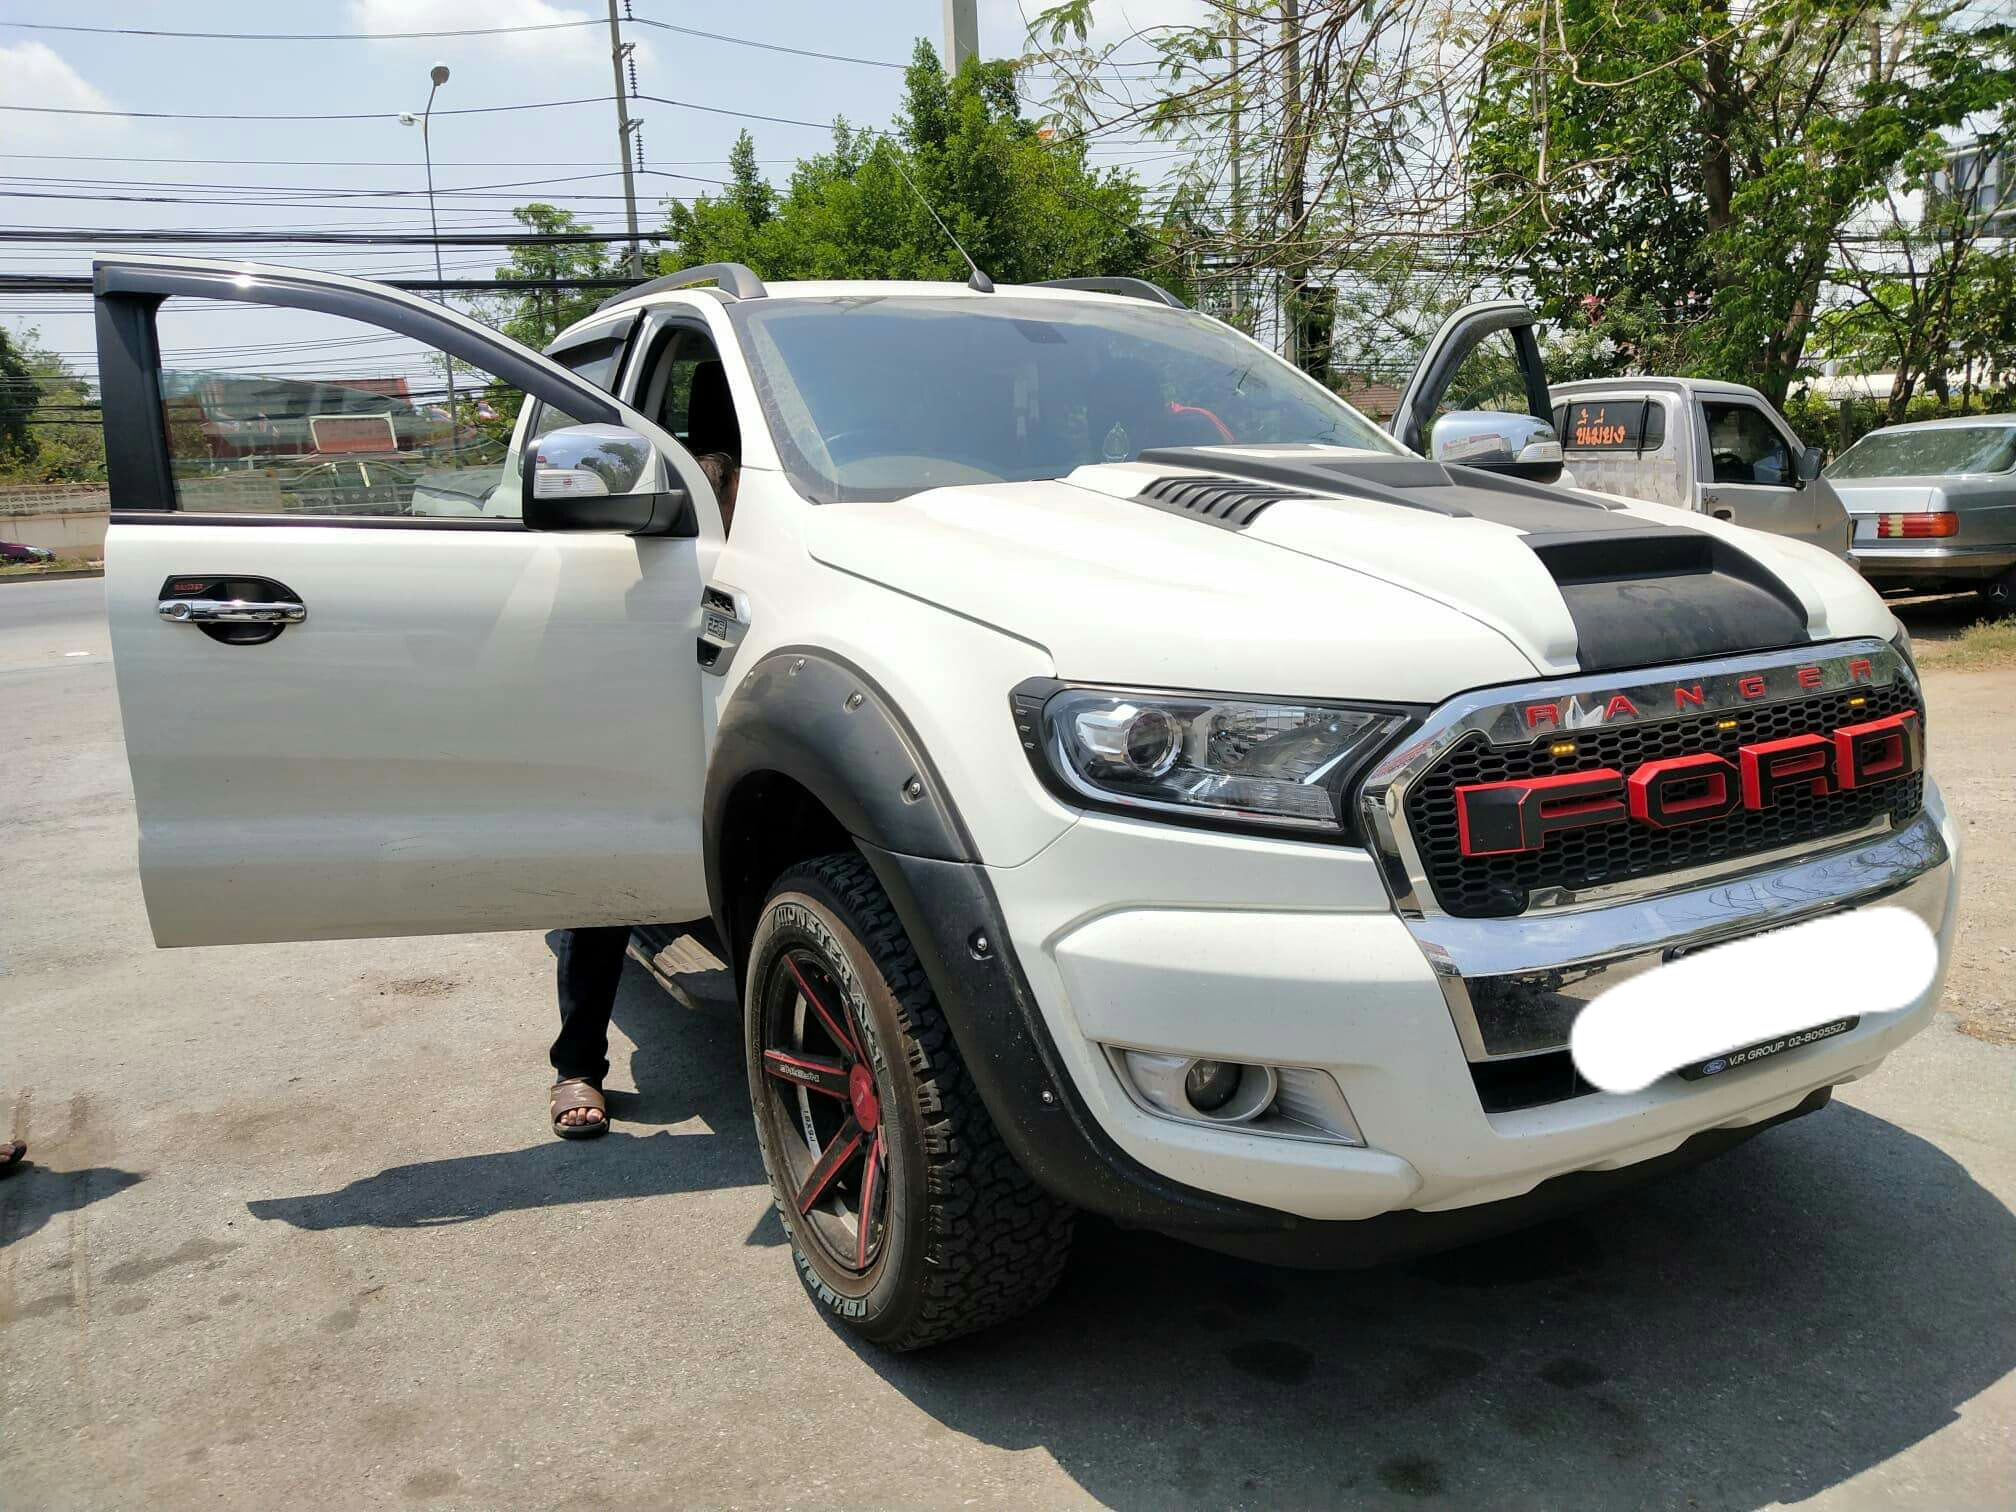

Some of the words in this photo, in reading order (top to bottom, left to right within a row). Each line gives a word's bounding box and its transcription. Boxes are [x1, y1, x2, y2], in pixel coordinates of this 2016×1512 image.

[1525, 659, 1873, 729] RANGER
[1456, 709, 1917, 856] FORD
[1729, 1054, 1746, 1066] V.P.
[1747, 1042, 1785, 1060] GROUP
[1788, 1022, 1846, 1048] 02-8095522
